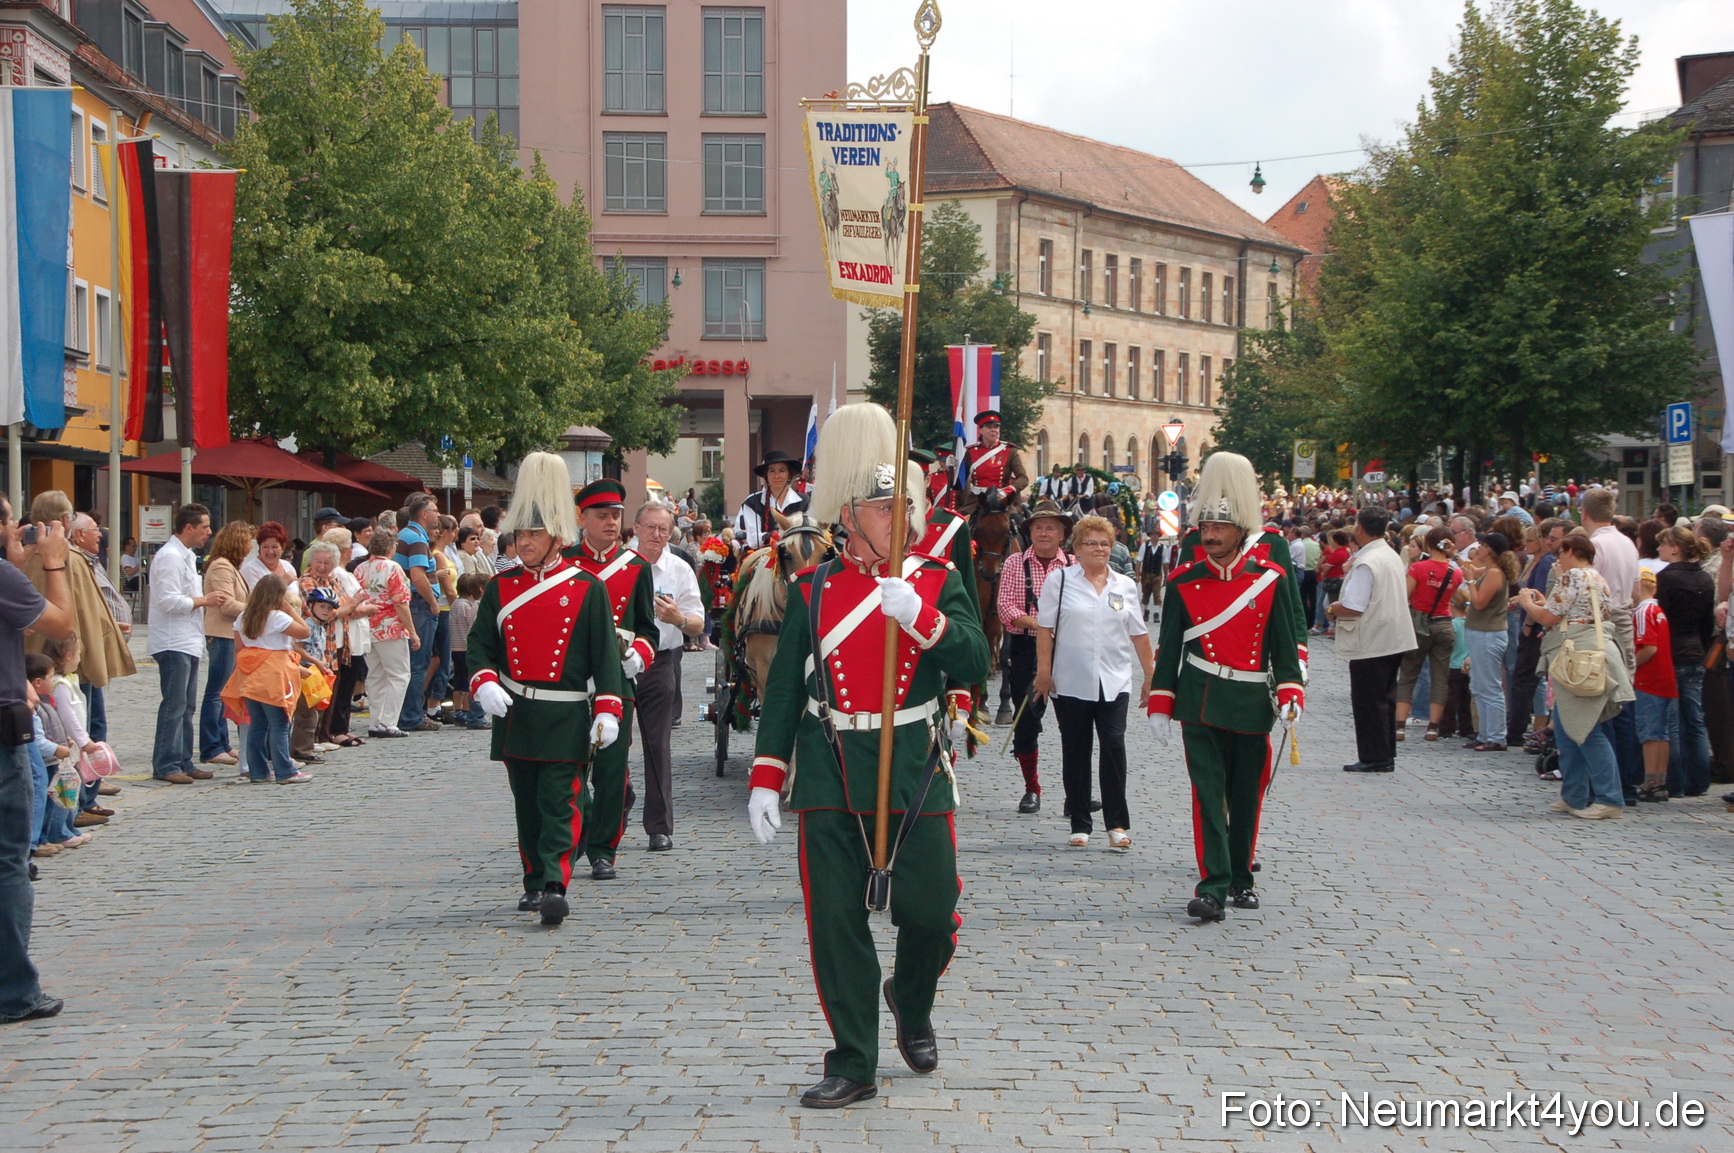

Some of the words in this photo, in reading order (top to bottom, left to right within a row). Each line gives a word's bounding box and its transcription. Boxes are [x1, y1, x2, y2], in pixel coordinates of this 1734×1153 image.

[816, 121, 902, 142] TRADITIONS-
[831, 146, 881, 167] VEREIN
[838, 261, 894, 285] ESKADRON
[1672, 408, 1687, 439] P
[1369, 473, 1381, 482] WC
